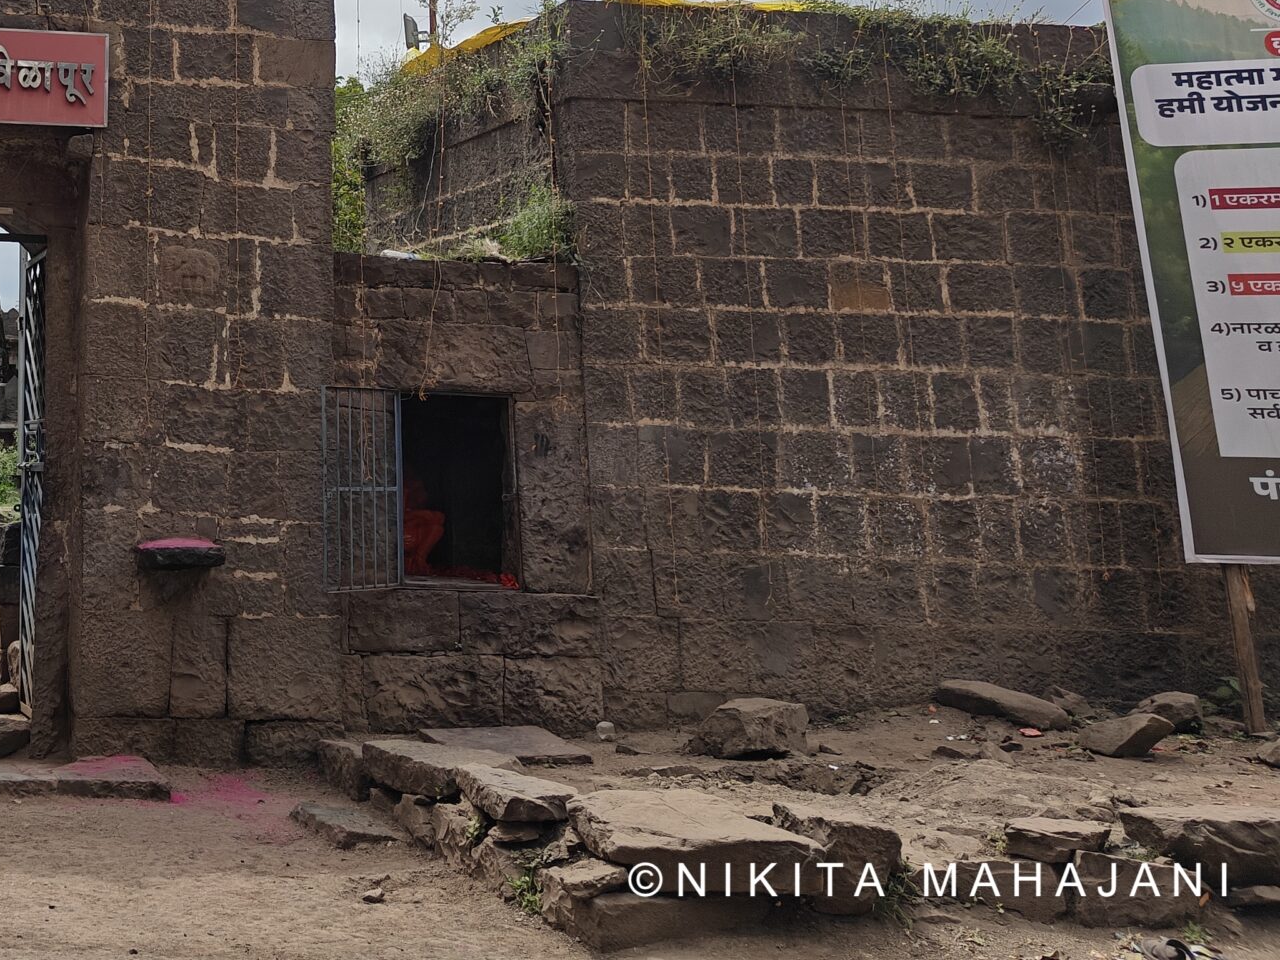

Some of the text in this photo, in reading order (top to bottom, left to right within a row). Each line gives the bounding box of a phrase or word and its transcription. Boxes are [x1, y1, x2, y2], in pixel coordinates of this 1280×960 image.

[1171, 68, 1265, 90] महात्मा
[1154, 91, 1206, 118] हमी
[1192, 194, 1207, 208] 1)
[1199, 236, 1218, 251] 2)
[1223, 237, 1235, 248] २
[1206, 280, 1226, 294] 3)
[1256, 340, 1273, 353] व
[1221, 387, 1241, 402] 5)
